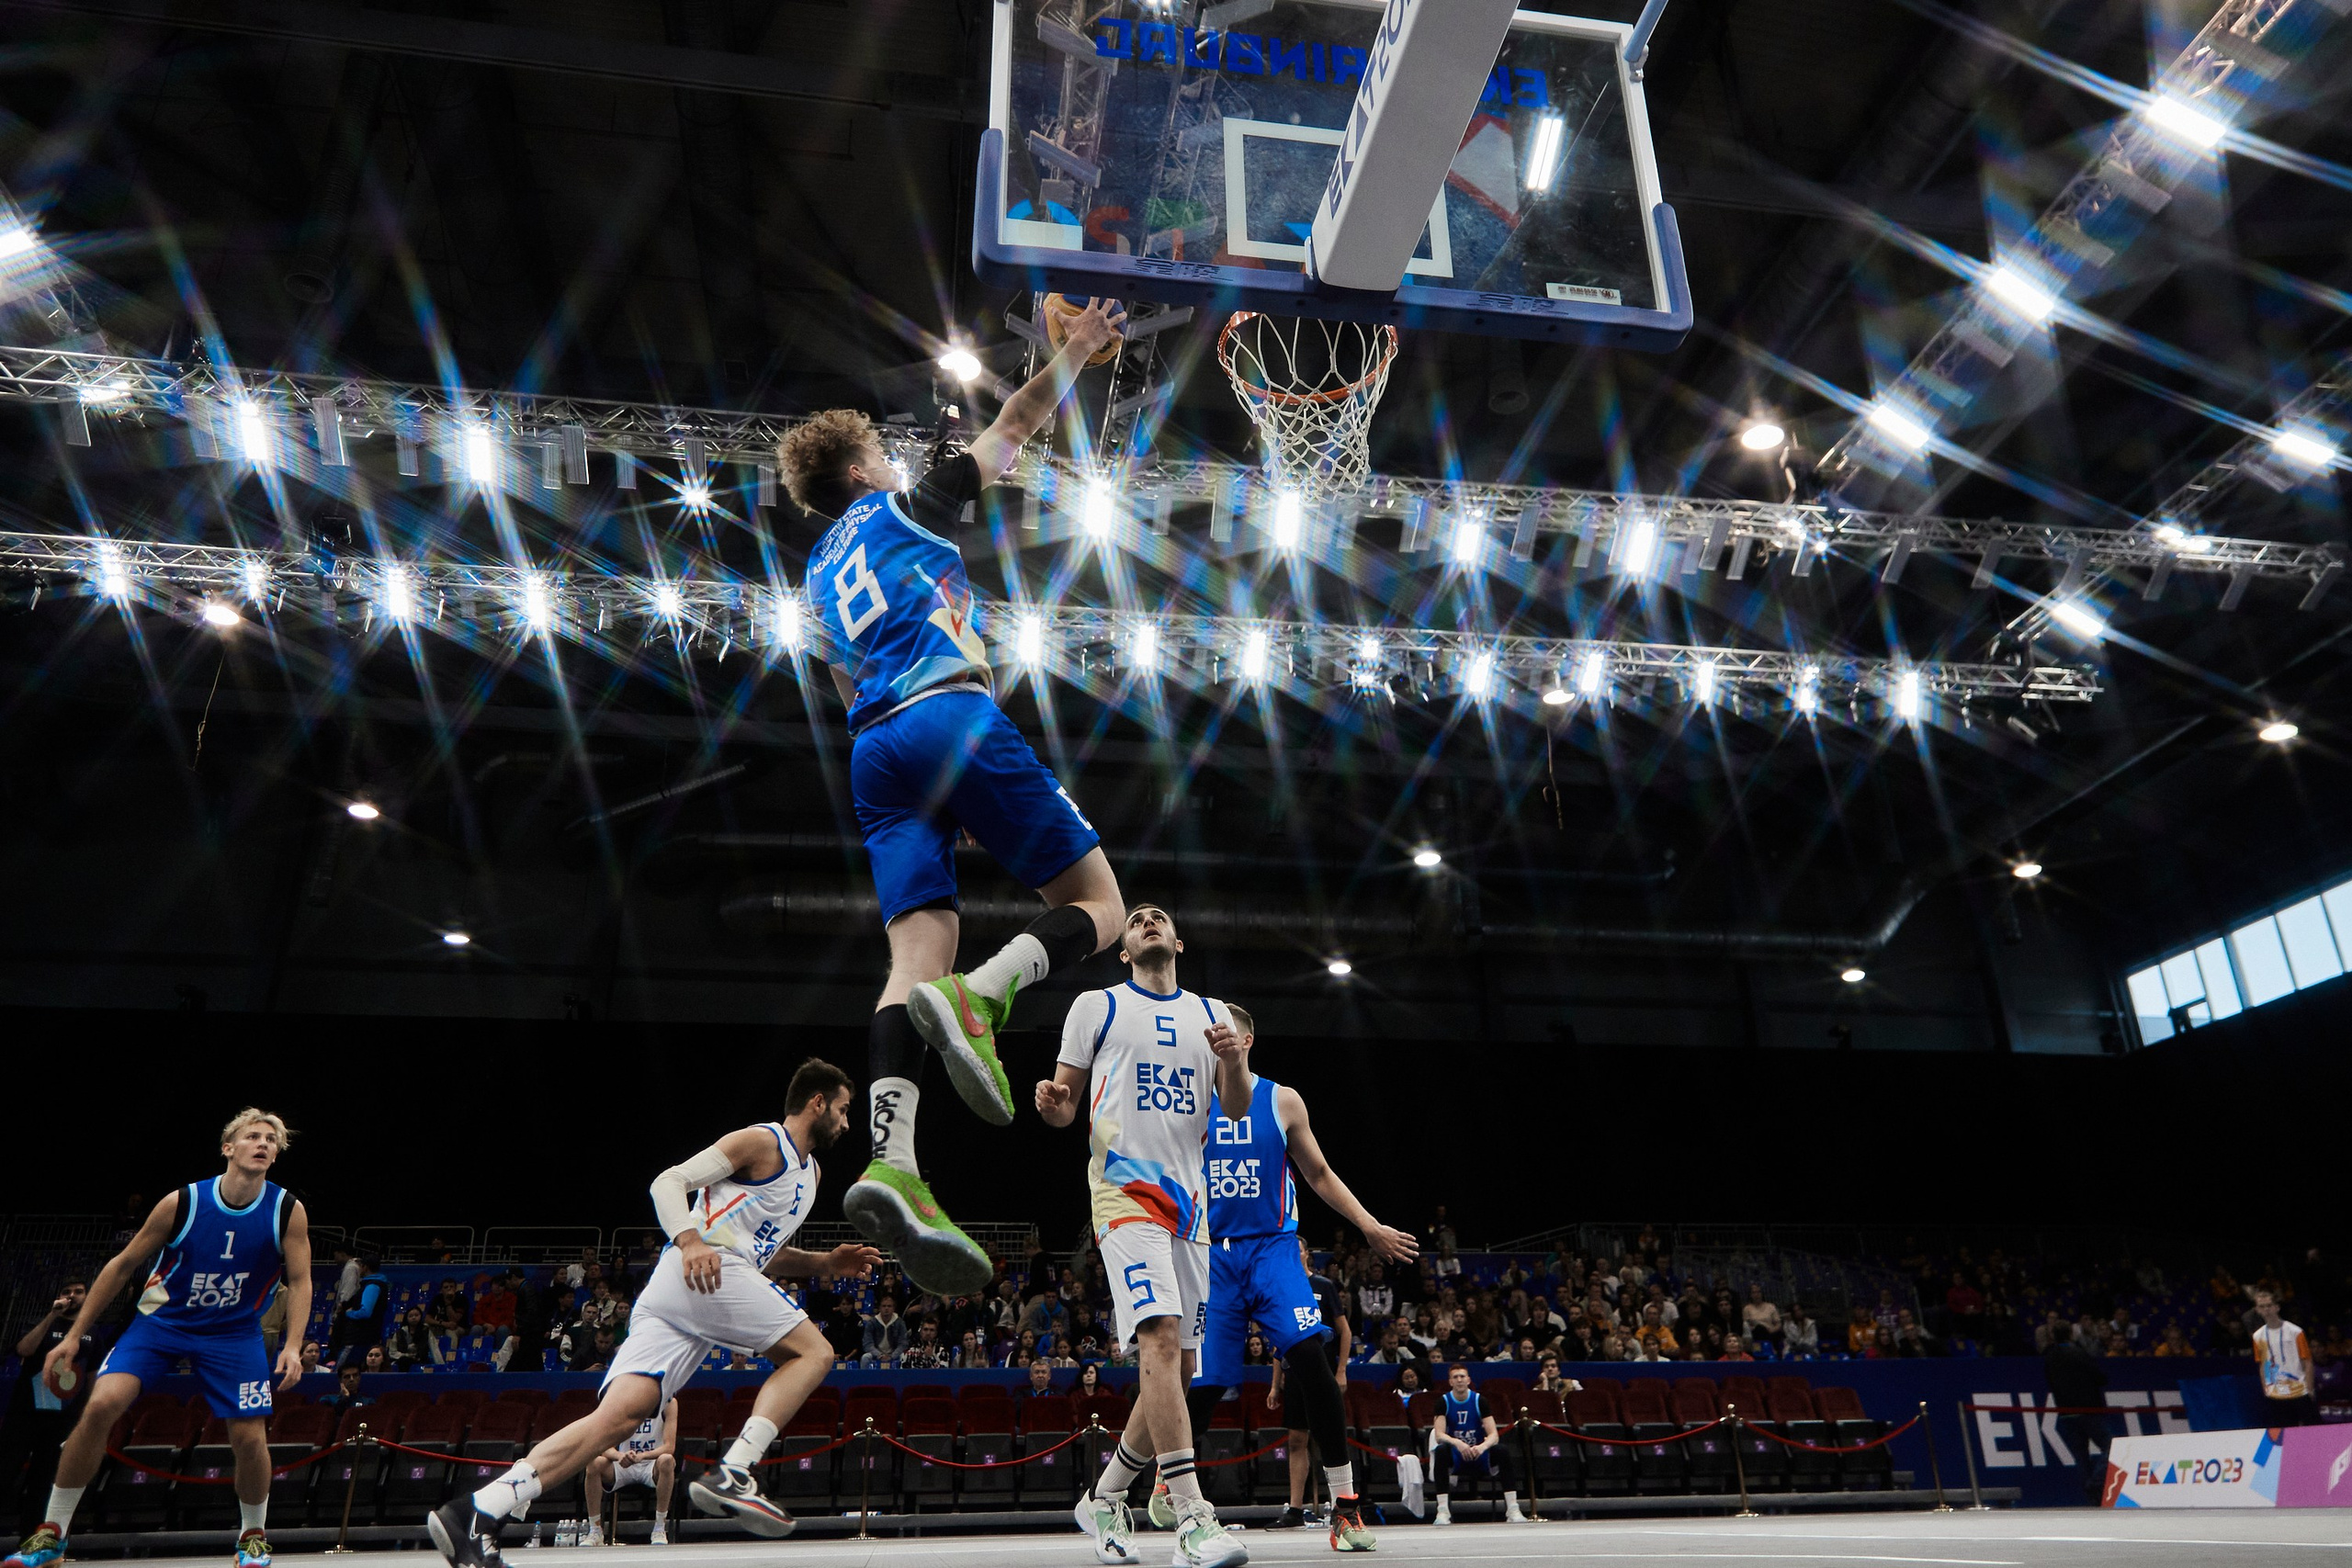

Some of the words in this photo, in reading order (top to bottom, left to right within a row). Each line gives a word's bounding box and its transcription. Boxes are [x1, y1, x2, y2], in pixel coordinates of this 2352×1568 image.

[1329, 0, 1411, 220] EKAT20
[813, 538, 841, 575] ACADEMY
[845, 502, 883, 533] PHYSICAL
[820, 518, 844, 558] MOSCOW
[842, 504, 871, 525] STATE
[833, 526, 859, 565] CULTURE
[833, 542, 889, 643] 8
[1155, 1015, 1177, 1047] 5
[1136, 1063, 1195, 1089] EKAT
[1136, 1085, 1196, 1115] 2023
[1216, 1116, 1252, 1145] 20
[1209, 1159, 1261, 1178] EKAT
[1210, 1177, 1261, 1199] 2023
[220, 1231, 235, 1259] 1
[191, 1272, 250, 1290] EKAT
[1124, 1261, 1157, 1311] 5
[186, 1289, 242, 1308] 2023
[1456, 1410, 1469, 1425] 17
[629, 1439, 656, 1450] EKAT
[2135, 1457, 2244, 1484] EKAT2023
